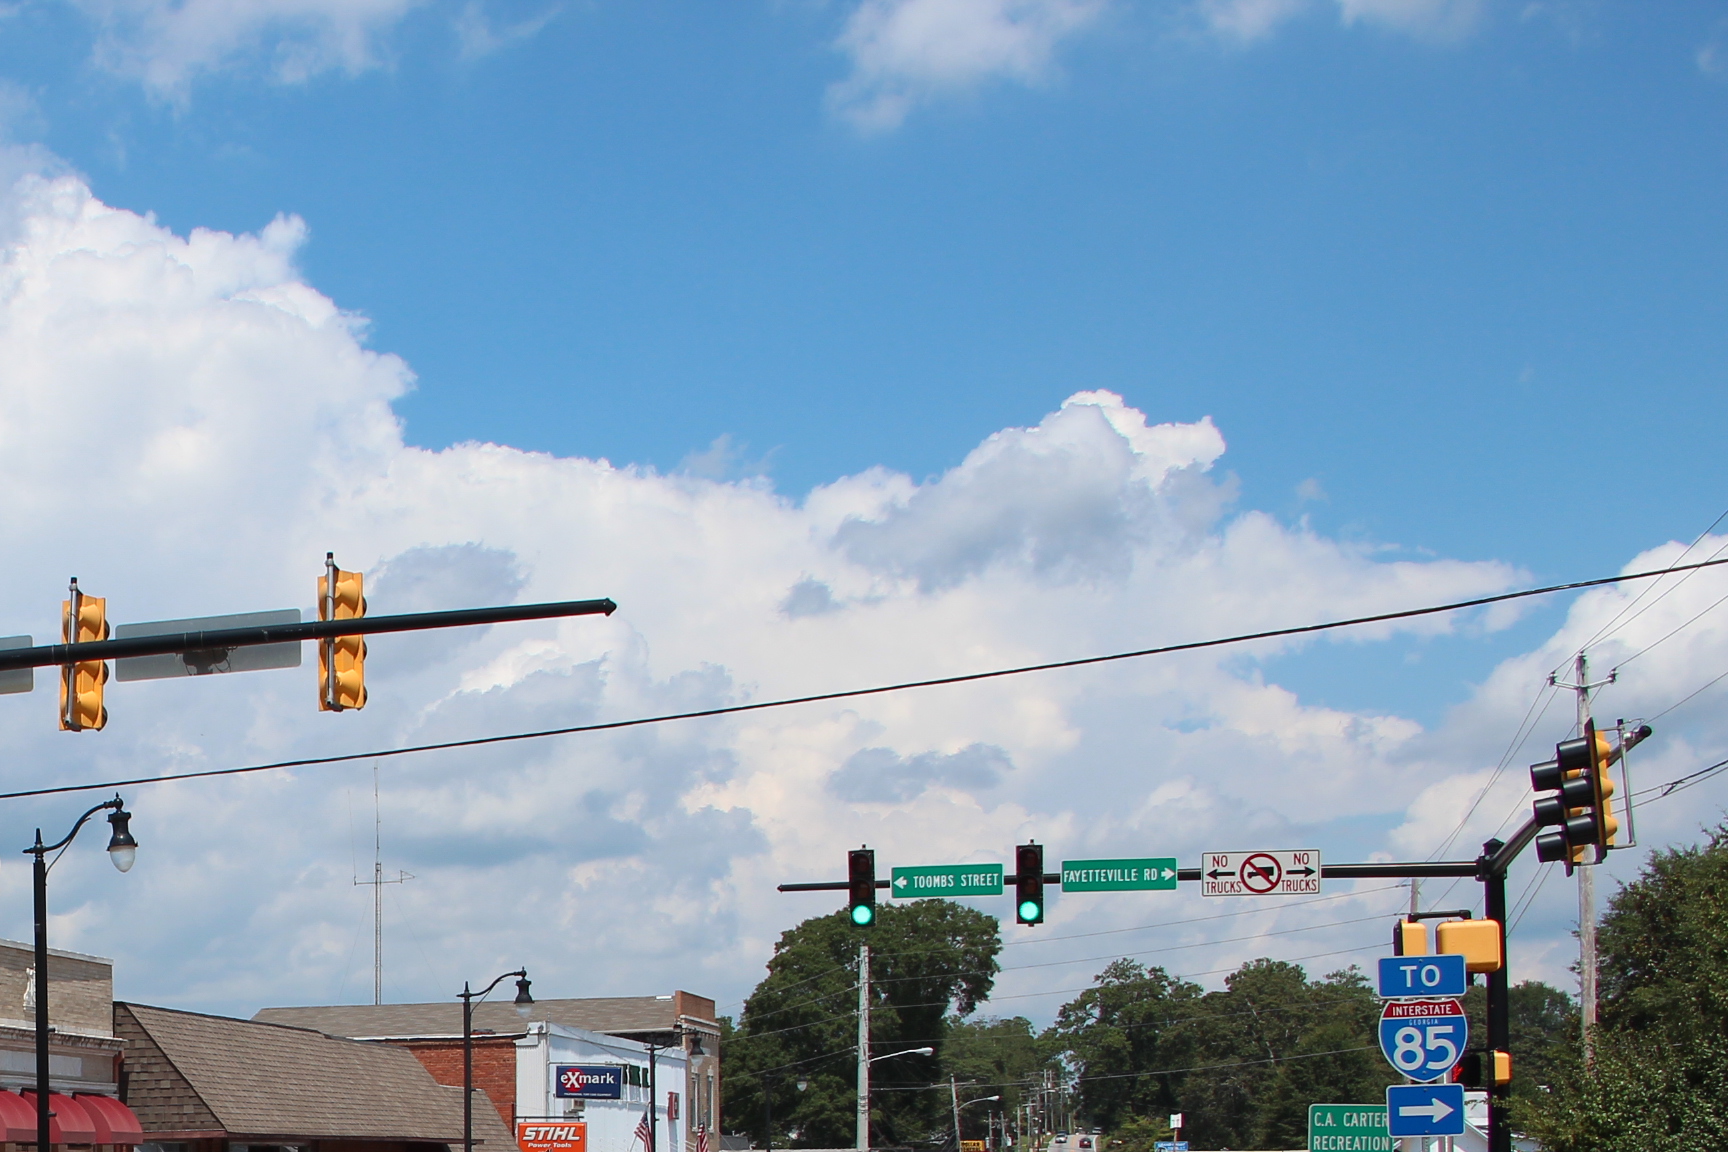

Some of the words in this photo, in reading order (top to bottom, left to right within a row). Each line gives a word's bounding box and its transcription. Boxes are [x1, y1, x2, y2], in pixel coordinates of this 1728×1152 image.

[1212, 855, 1228, 868] NO
[1293, 853, 1310, 866] NO
[913, 875, 954, 888] TOOMBS
[960, 873, 999, 887] STREET
[1063, 868, 1138, 883] FAYETTEVILLE
[1144, 867, 1158, 882] RD
[1206, 881, 1242, 894] TRUCKS
[1281, 879, 1317, 892] TRUCKS
[1399, 965, 1441, 988] TO
[1392, 1004, 1452, 1016] INTERSTATE
[1393, 1025, 1457, 1071] 85
[1314, 1112, 1337, 1127] C.A.
[1343, 1112, 1388, 1128] CARTER
[522, 1126, 580, 1141] STIHL
[1313, 1136, 1390, 1151] RECREATION
